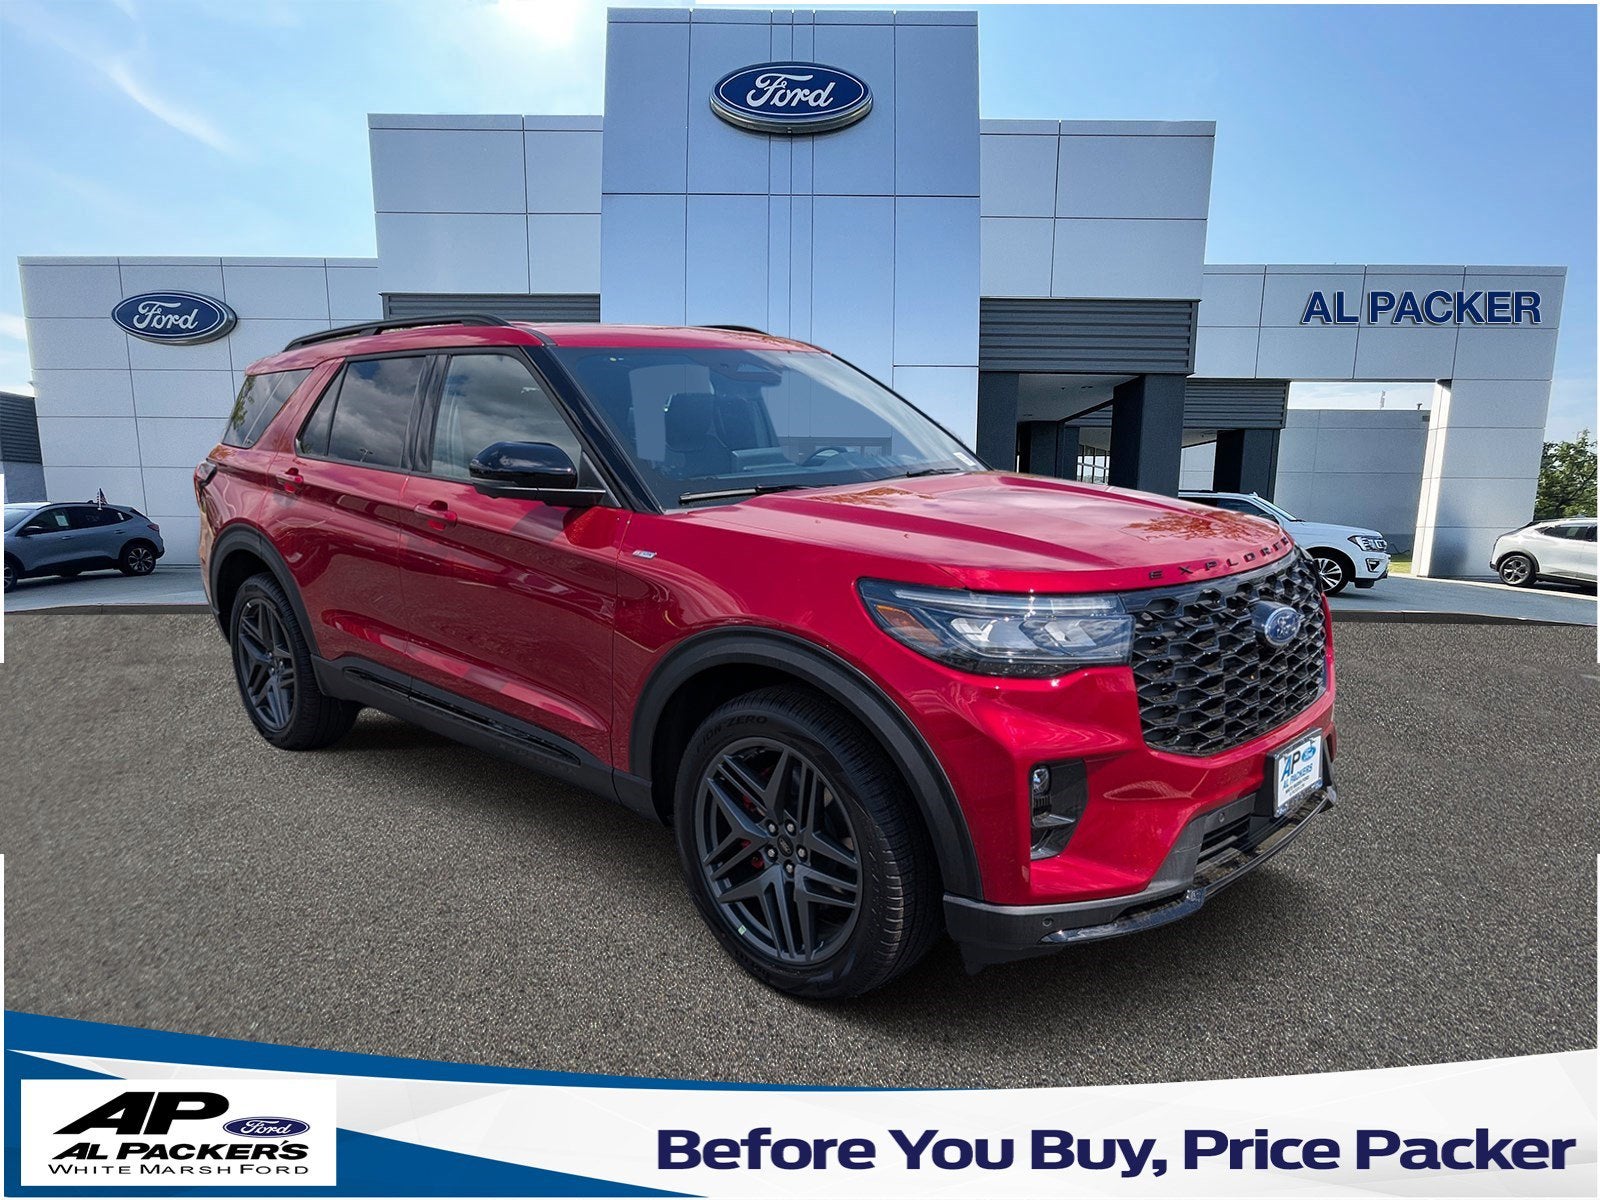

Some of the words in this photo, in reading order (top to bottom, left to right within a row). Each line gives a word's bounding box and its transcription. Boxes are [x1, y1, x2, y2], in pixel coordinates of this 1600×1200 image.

[746, 73, 836, 107] Ford
[133, 301, 199, 329] Ford
[1301, 290, 1360, 324] AL
[1368, 290, 1542, 325] PACKER
[1148, 537, 1290, 580] EXPLORER
[1281, 750, 1301, 782] AP
